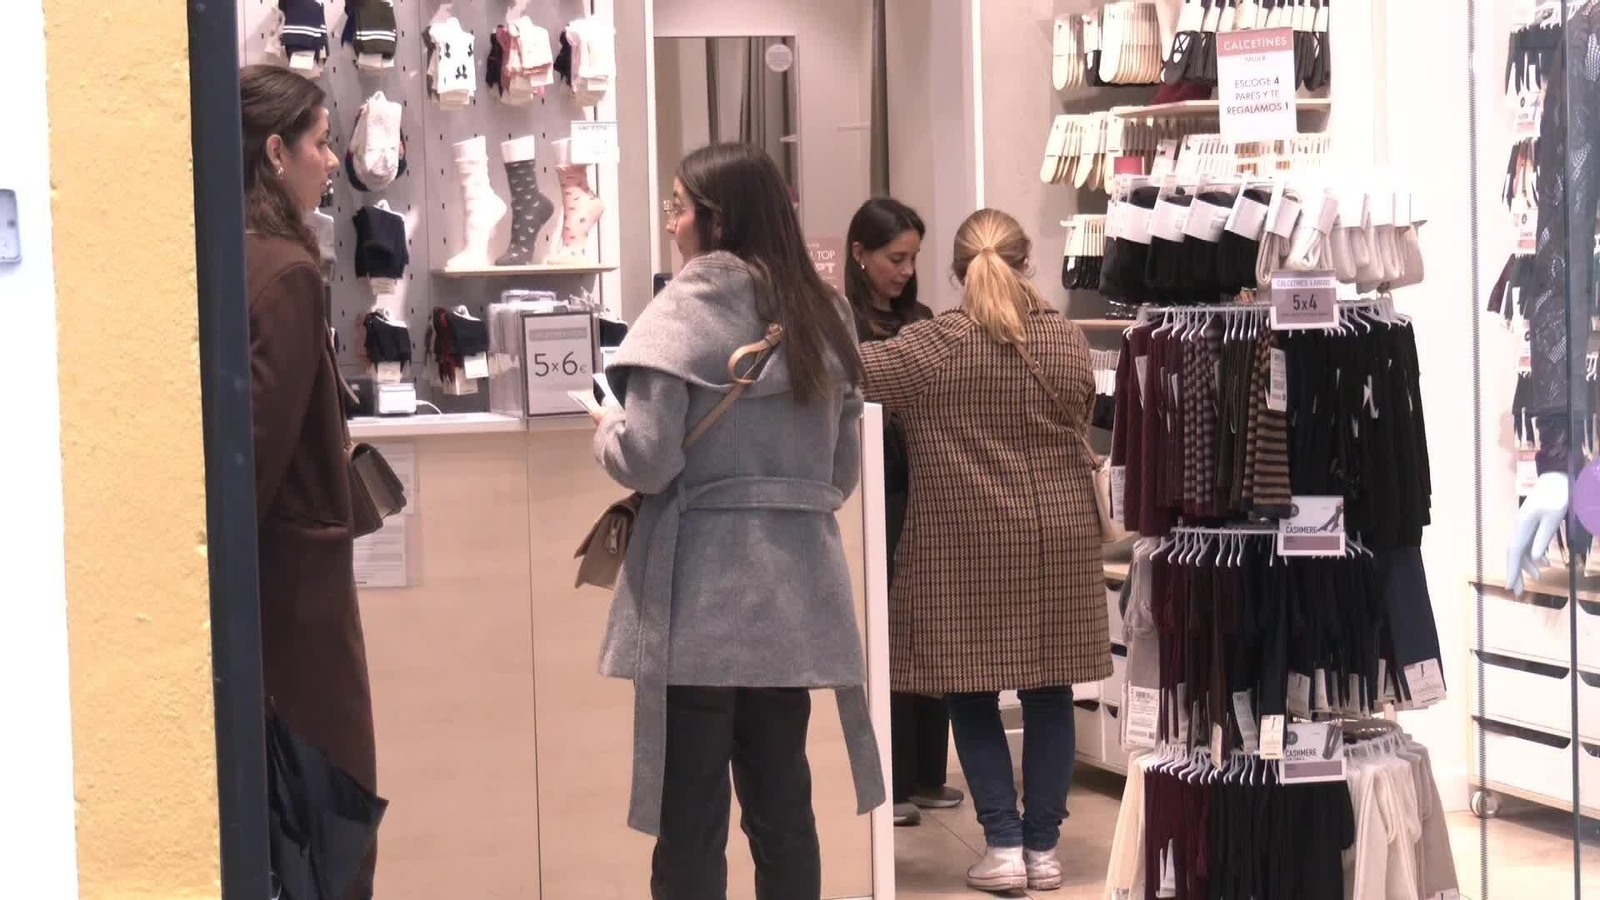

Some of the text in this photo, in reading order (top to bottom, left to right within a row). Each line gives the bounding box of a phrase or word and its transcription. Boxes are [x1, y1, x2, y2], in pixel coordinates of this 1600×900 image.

[1224, 36, 1287, 51] CALCETINES
[1235, 78, 1271, 89] ESCOGE
[1235, 89, 1279, 101] PARES Y TE
[1227, 103, 1282, 115] REGALAMOS
[816, 250, 836, 261] TOP
[814, 262, 836, 274] PT
[1285, 526, 1318, 534] CASHMERE
[1285, 748, 1318, 758] CASHMERE
